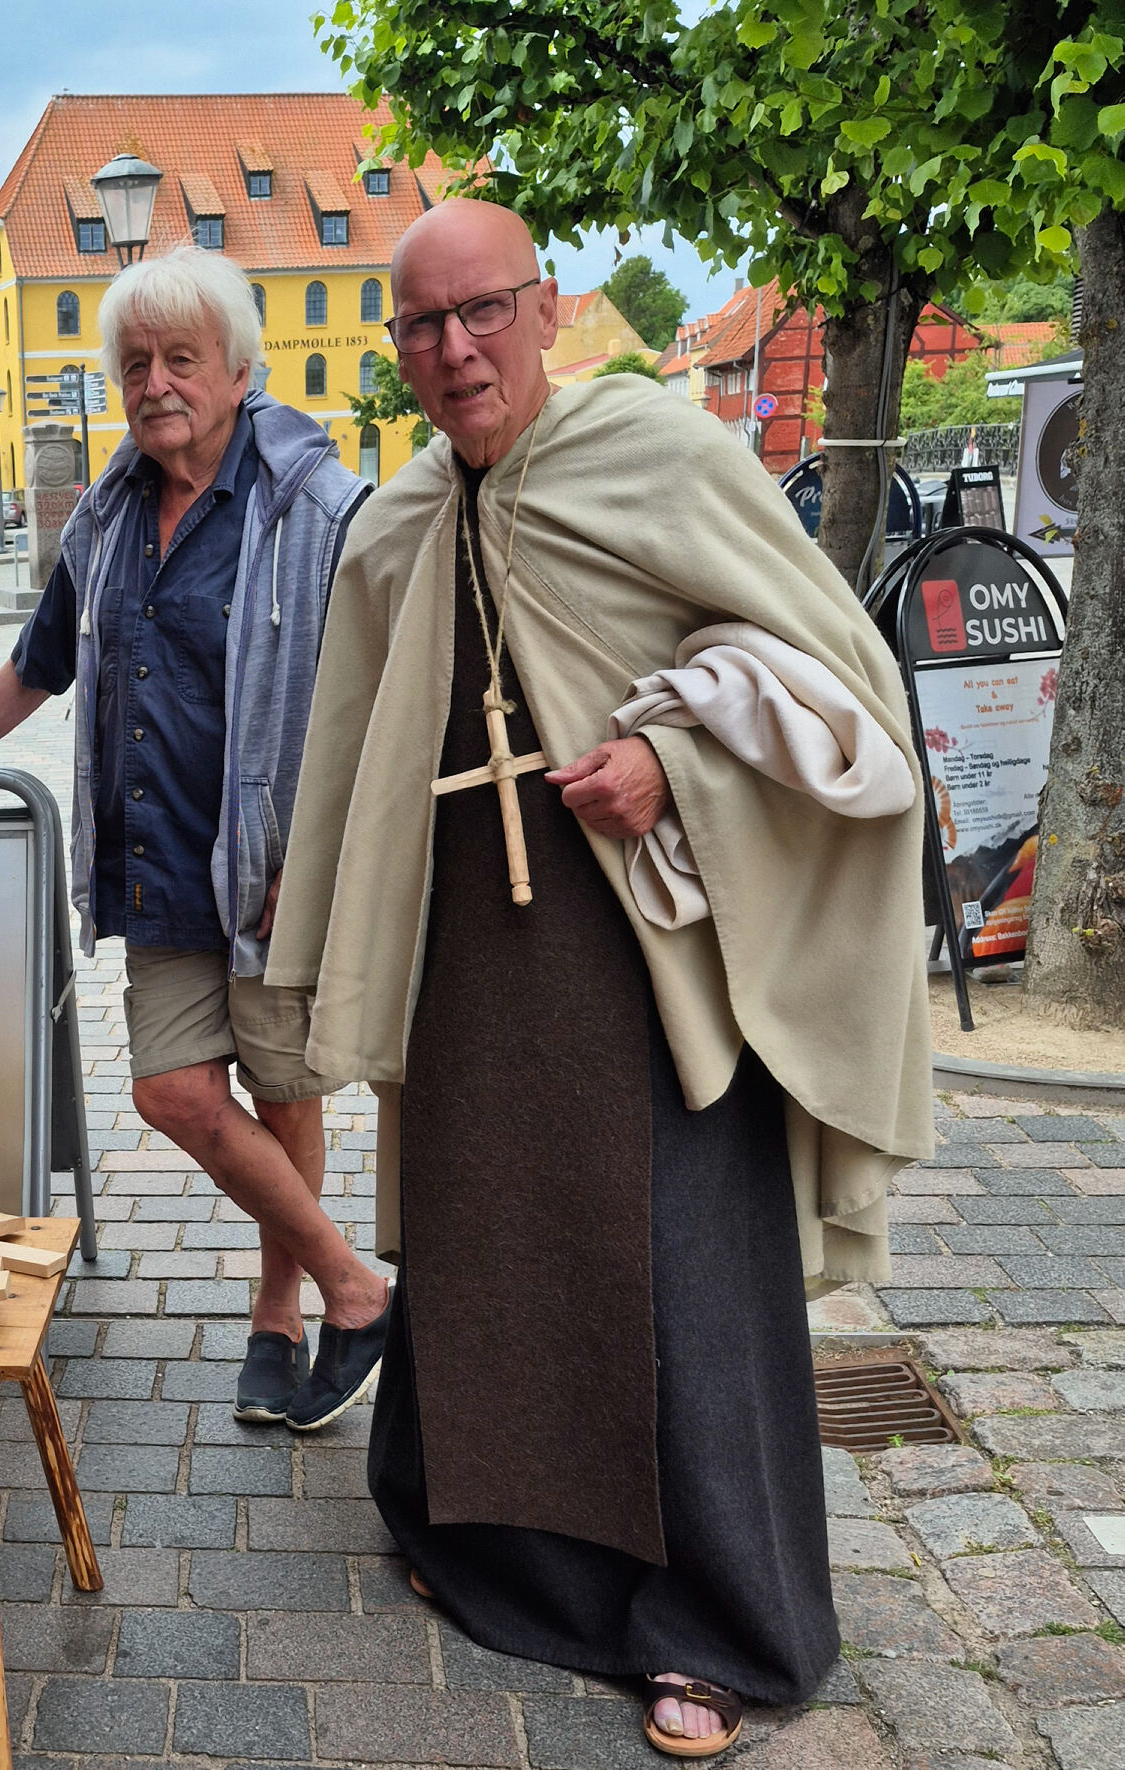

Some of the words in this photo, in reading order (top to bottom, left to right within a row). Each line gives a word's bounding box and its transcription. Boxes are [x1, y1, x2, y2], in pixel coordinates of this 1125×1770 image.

[264, 336, 342, 351] DAMPMØLLE
[346, 335, 368, 347] 1853
[962, 471, 994, 483] TUBORG
[969, 582, 1029, 611] OMY
[965, 616, 1047, 646] SUSHI
[964, 680, 973, 688] All
[976, 681, 989, 689] you
[1006, 676, 1018, 685] eat
[975, 704, 992, 713] Take
[995, 704, 1014, 712] away
[961, 772, 976, 780] under
[962, 782, 978, 790] under
